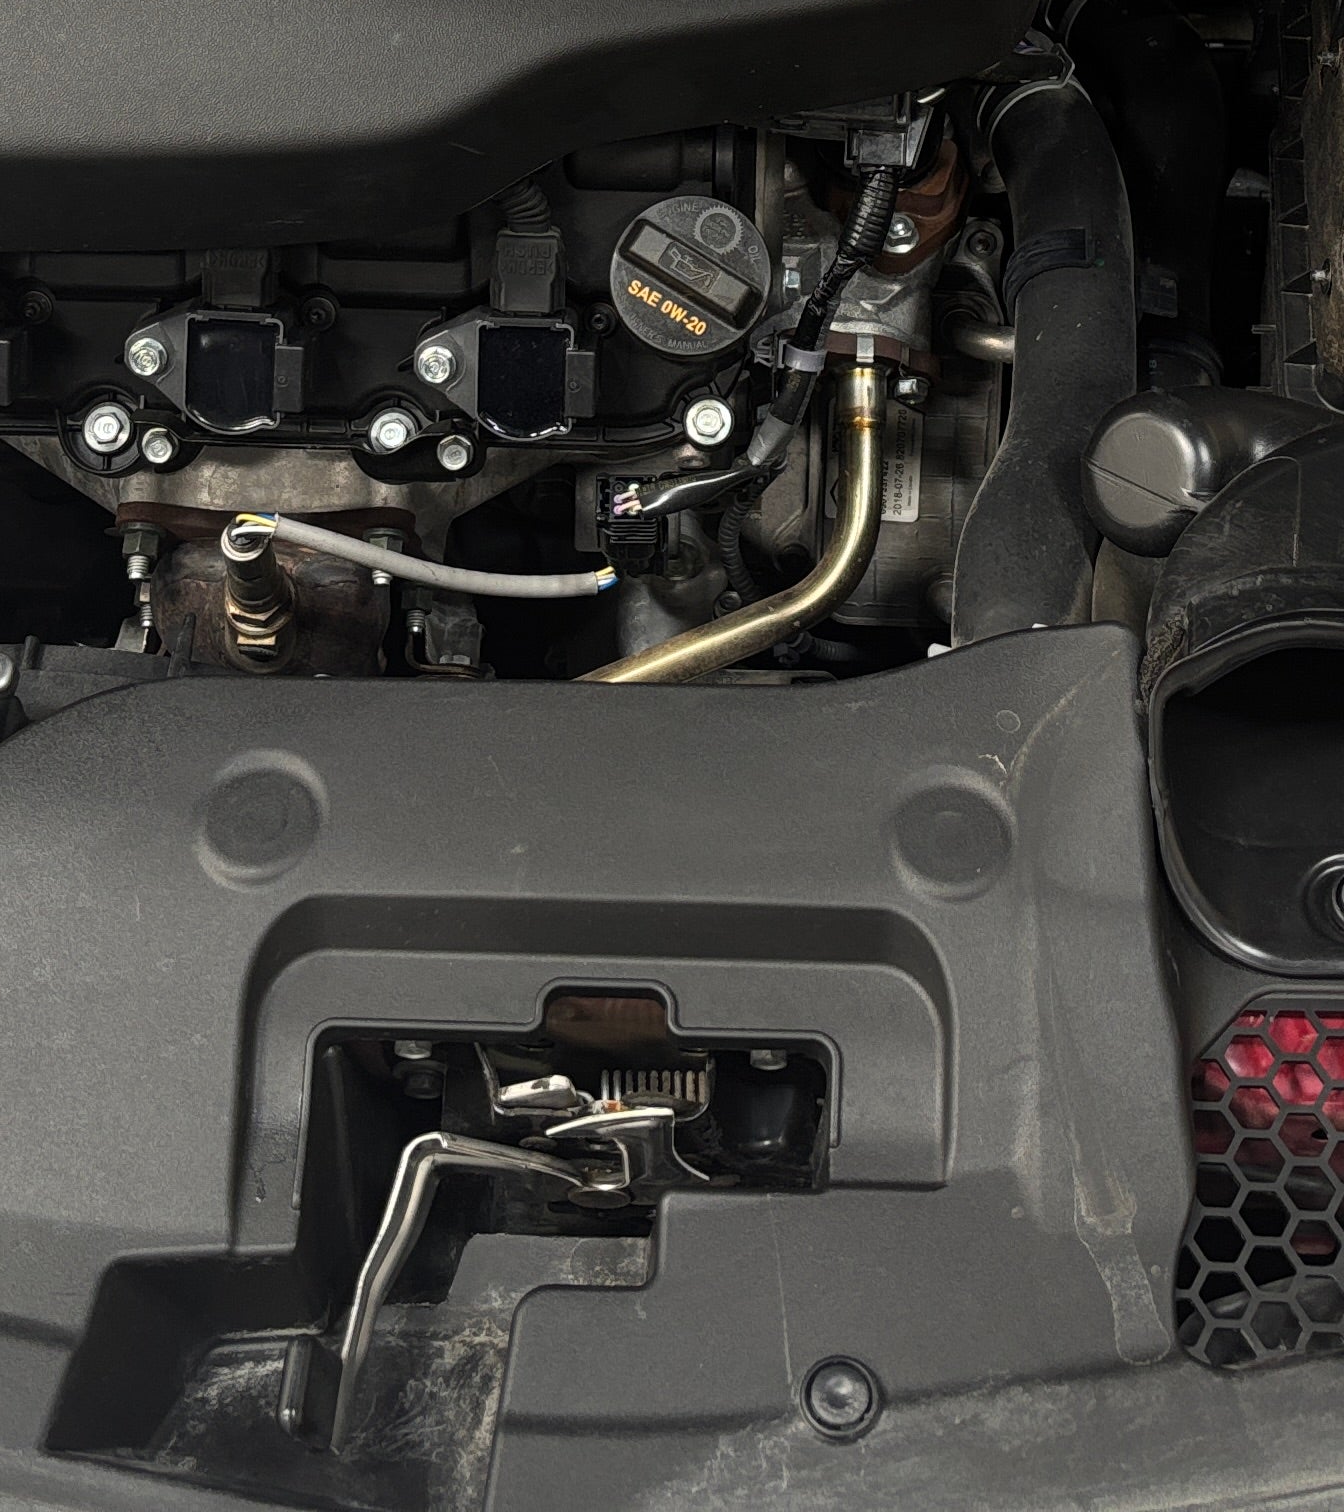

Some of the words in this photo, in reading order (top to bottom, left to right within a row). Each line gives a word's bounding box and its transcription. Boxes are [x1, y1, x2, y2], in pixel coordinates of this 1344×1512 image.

[747, 245, 762, 268] OIL
[627, 279, 662, 308] SAE
[661, 300, 707, 336] 0W-20
